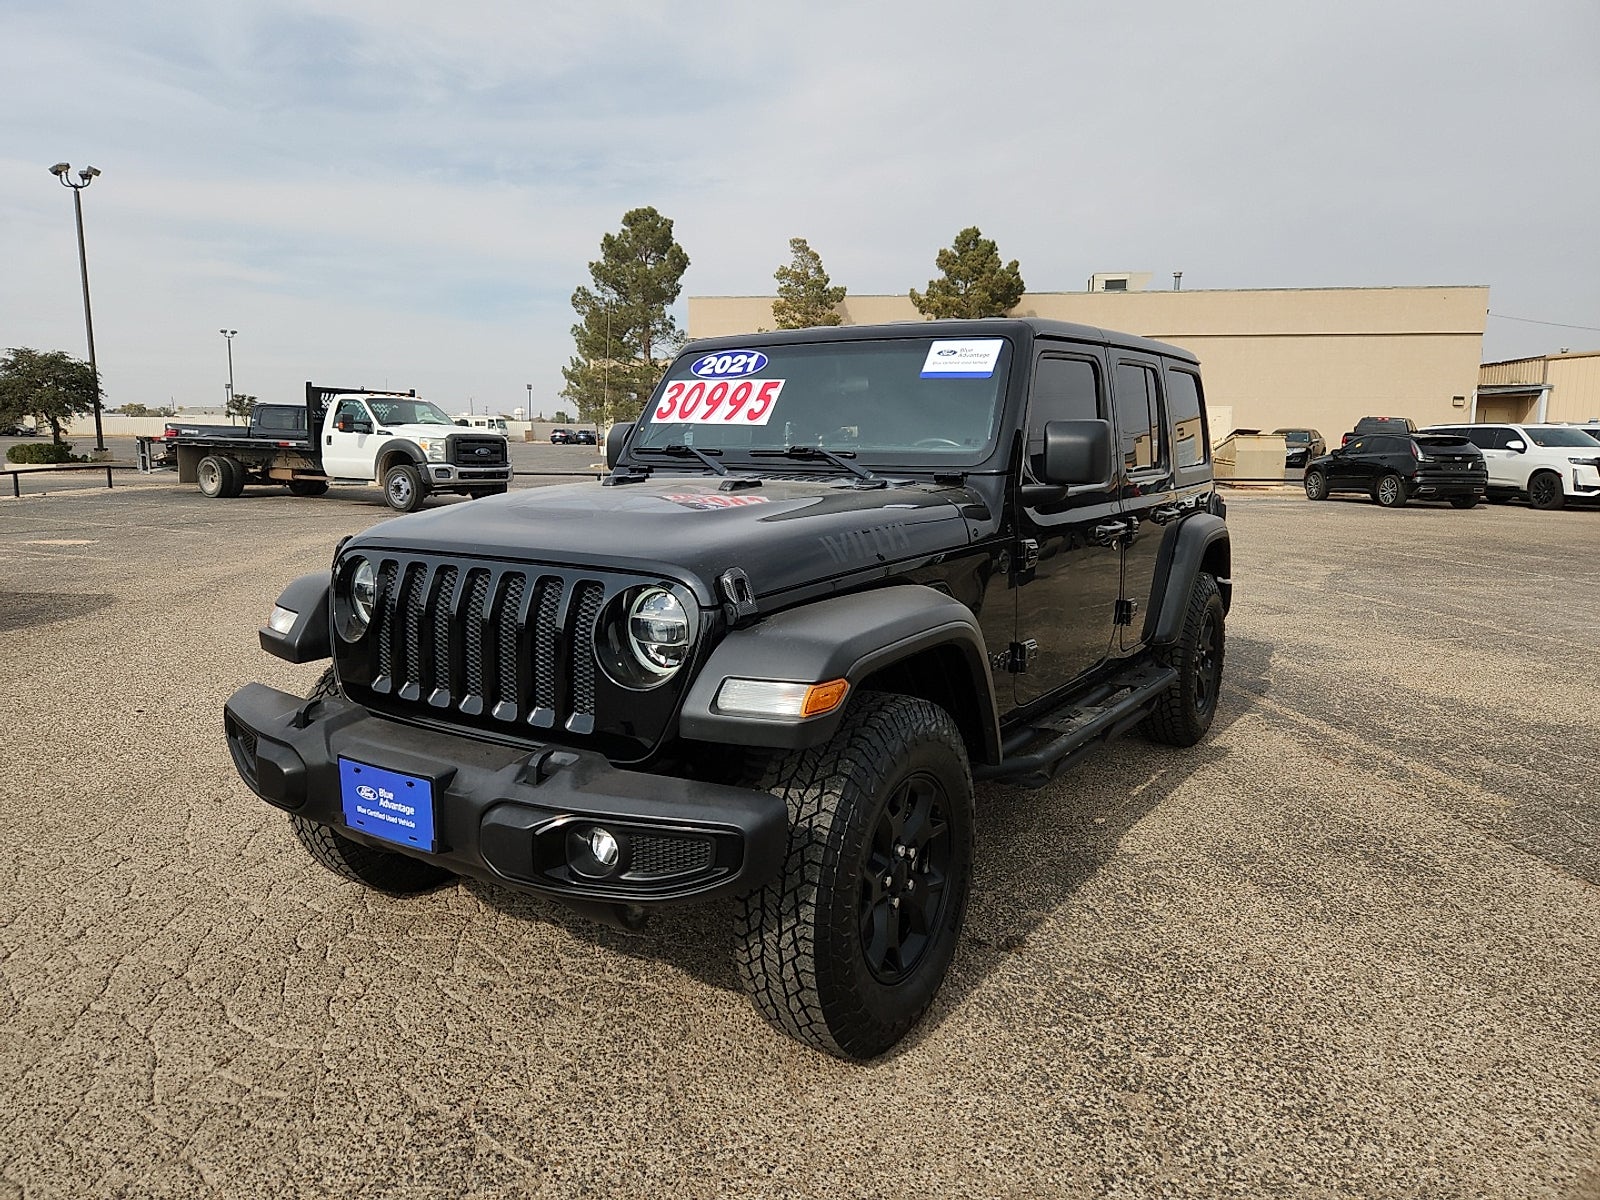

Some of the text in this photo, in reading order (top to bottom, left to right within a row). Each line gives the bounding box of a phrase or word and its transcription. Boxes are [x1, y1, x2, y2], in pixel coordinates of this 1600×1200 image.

[697, 353, 760, 375] 2021
[656, 381, 781, 421] 30995
[379, 788, 394, 799] Blue
[356, 805, 416, 828] Blue Certified Used Vehicle
[379, 798, 415, 815] Advantage
